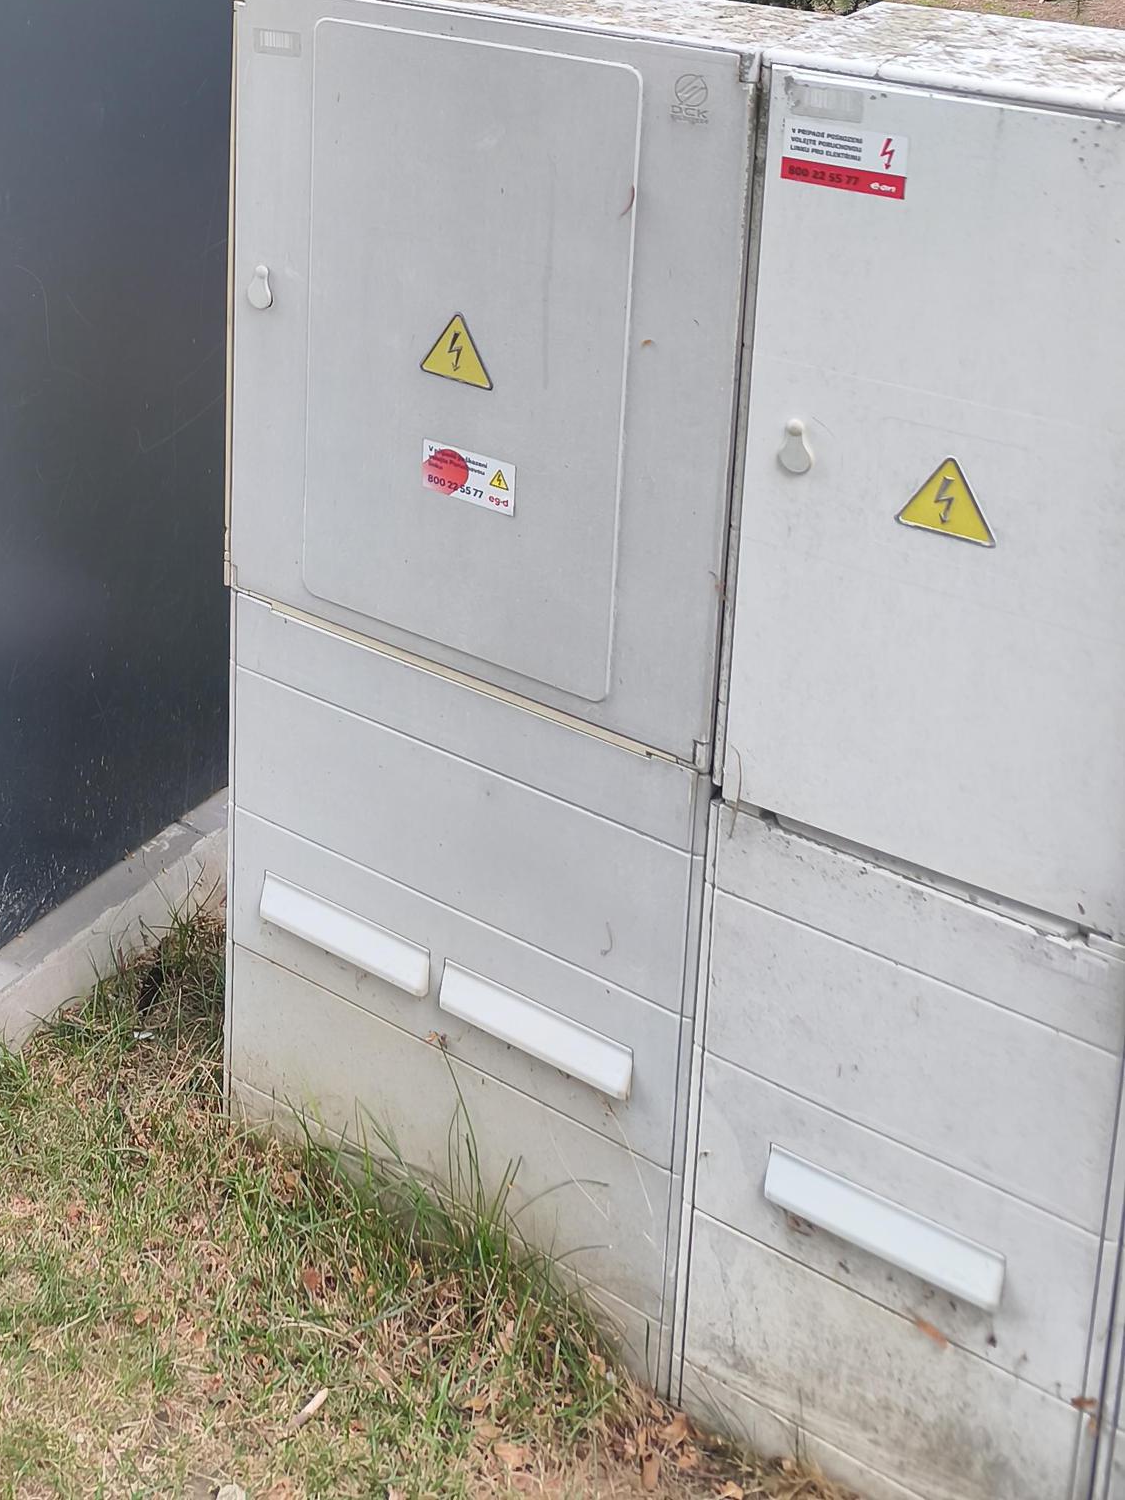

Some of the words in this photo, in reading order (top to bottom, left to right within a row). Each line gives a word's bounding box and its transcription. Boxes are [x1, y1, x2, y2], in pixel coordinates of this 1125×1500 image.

[788, 165, 809, 177] 800
[812, 170, 826, 180] 22
[828, 172, 843, 183] 55
[845, 175, 860, 186] 77
[427, 474, 446, 487] 800
[447, 480, 458, 491] 22
[459, 484, 471, 495] 55
[472, 488, 484, 499] 77
